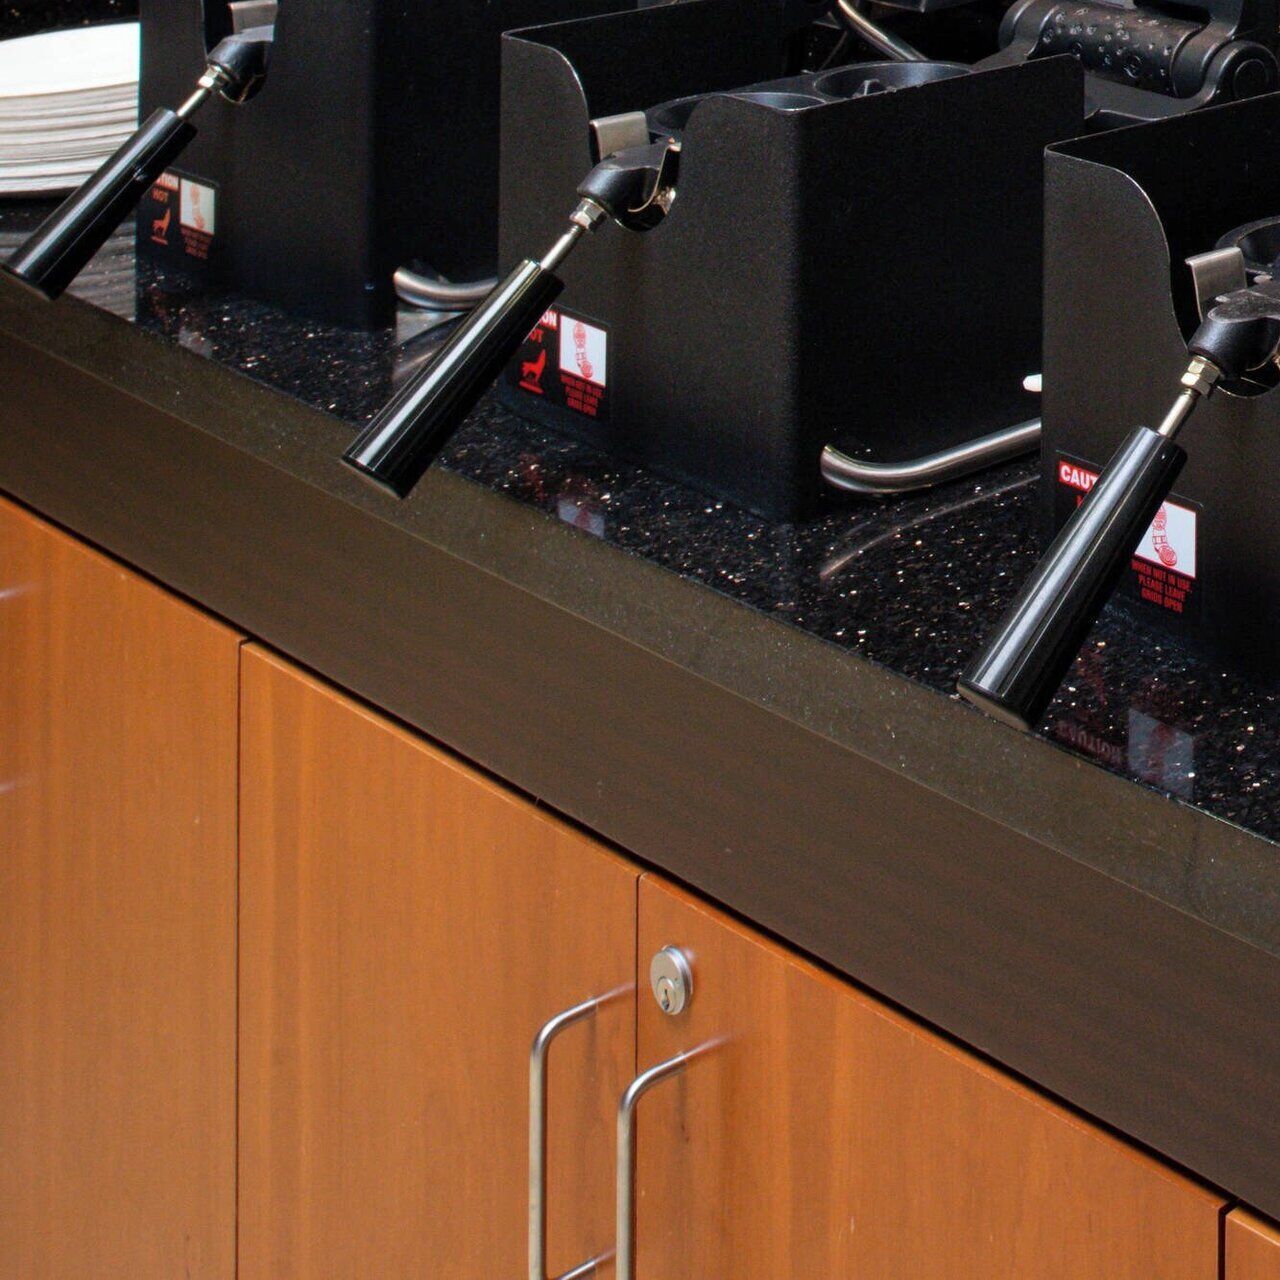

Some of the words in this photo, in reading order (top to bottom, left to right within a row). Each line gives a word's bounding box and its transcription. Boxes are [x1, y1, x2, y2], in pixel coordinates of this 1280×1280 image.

[1153, 567, 1166, 582] NOT
[1168, 573, 1176, 587] IN
[1138, 573, 1164, 593] PLEASE
[1165, 584, 1187, 602] LEAVE
[1164, 596, 1184, 614] OPEN
